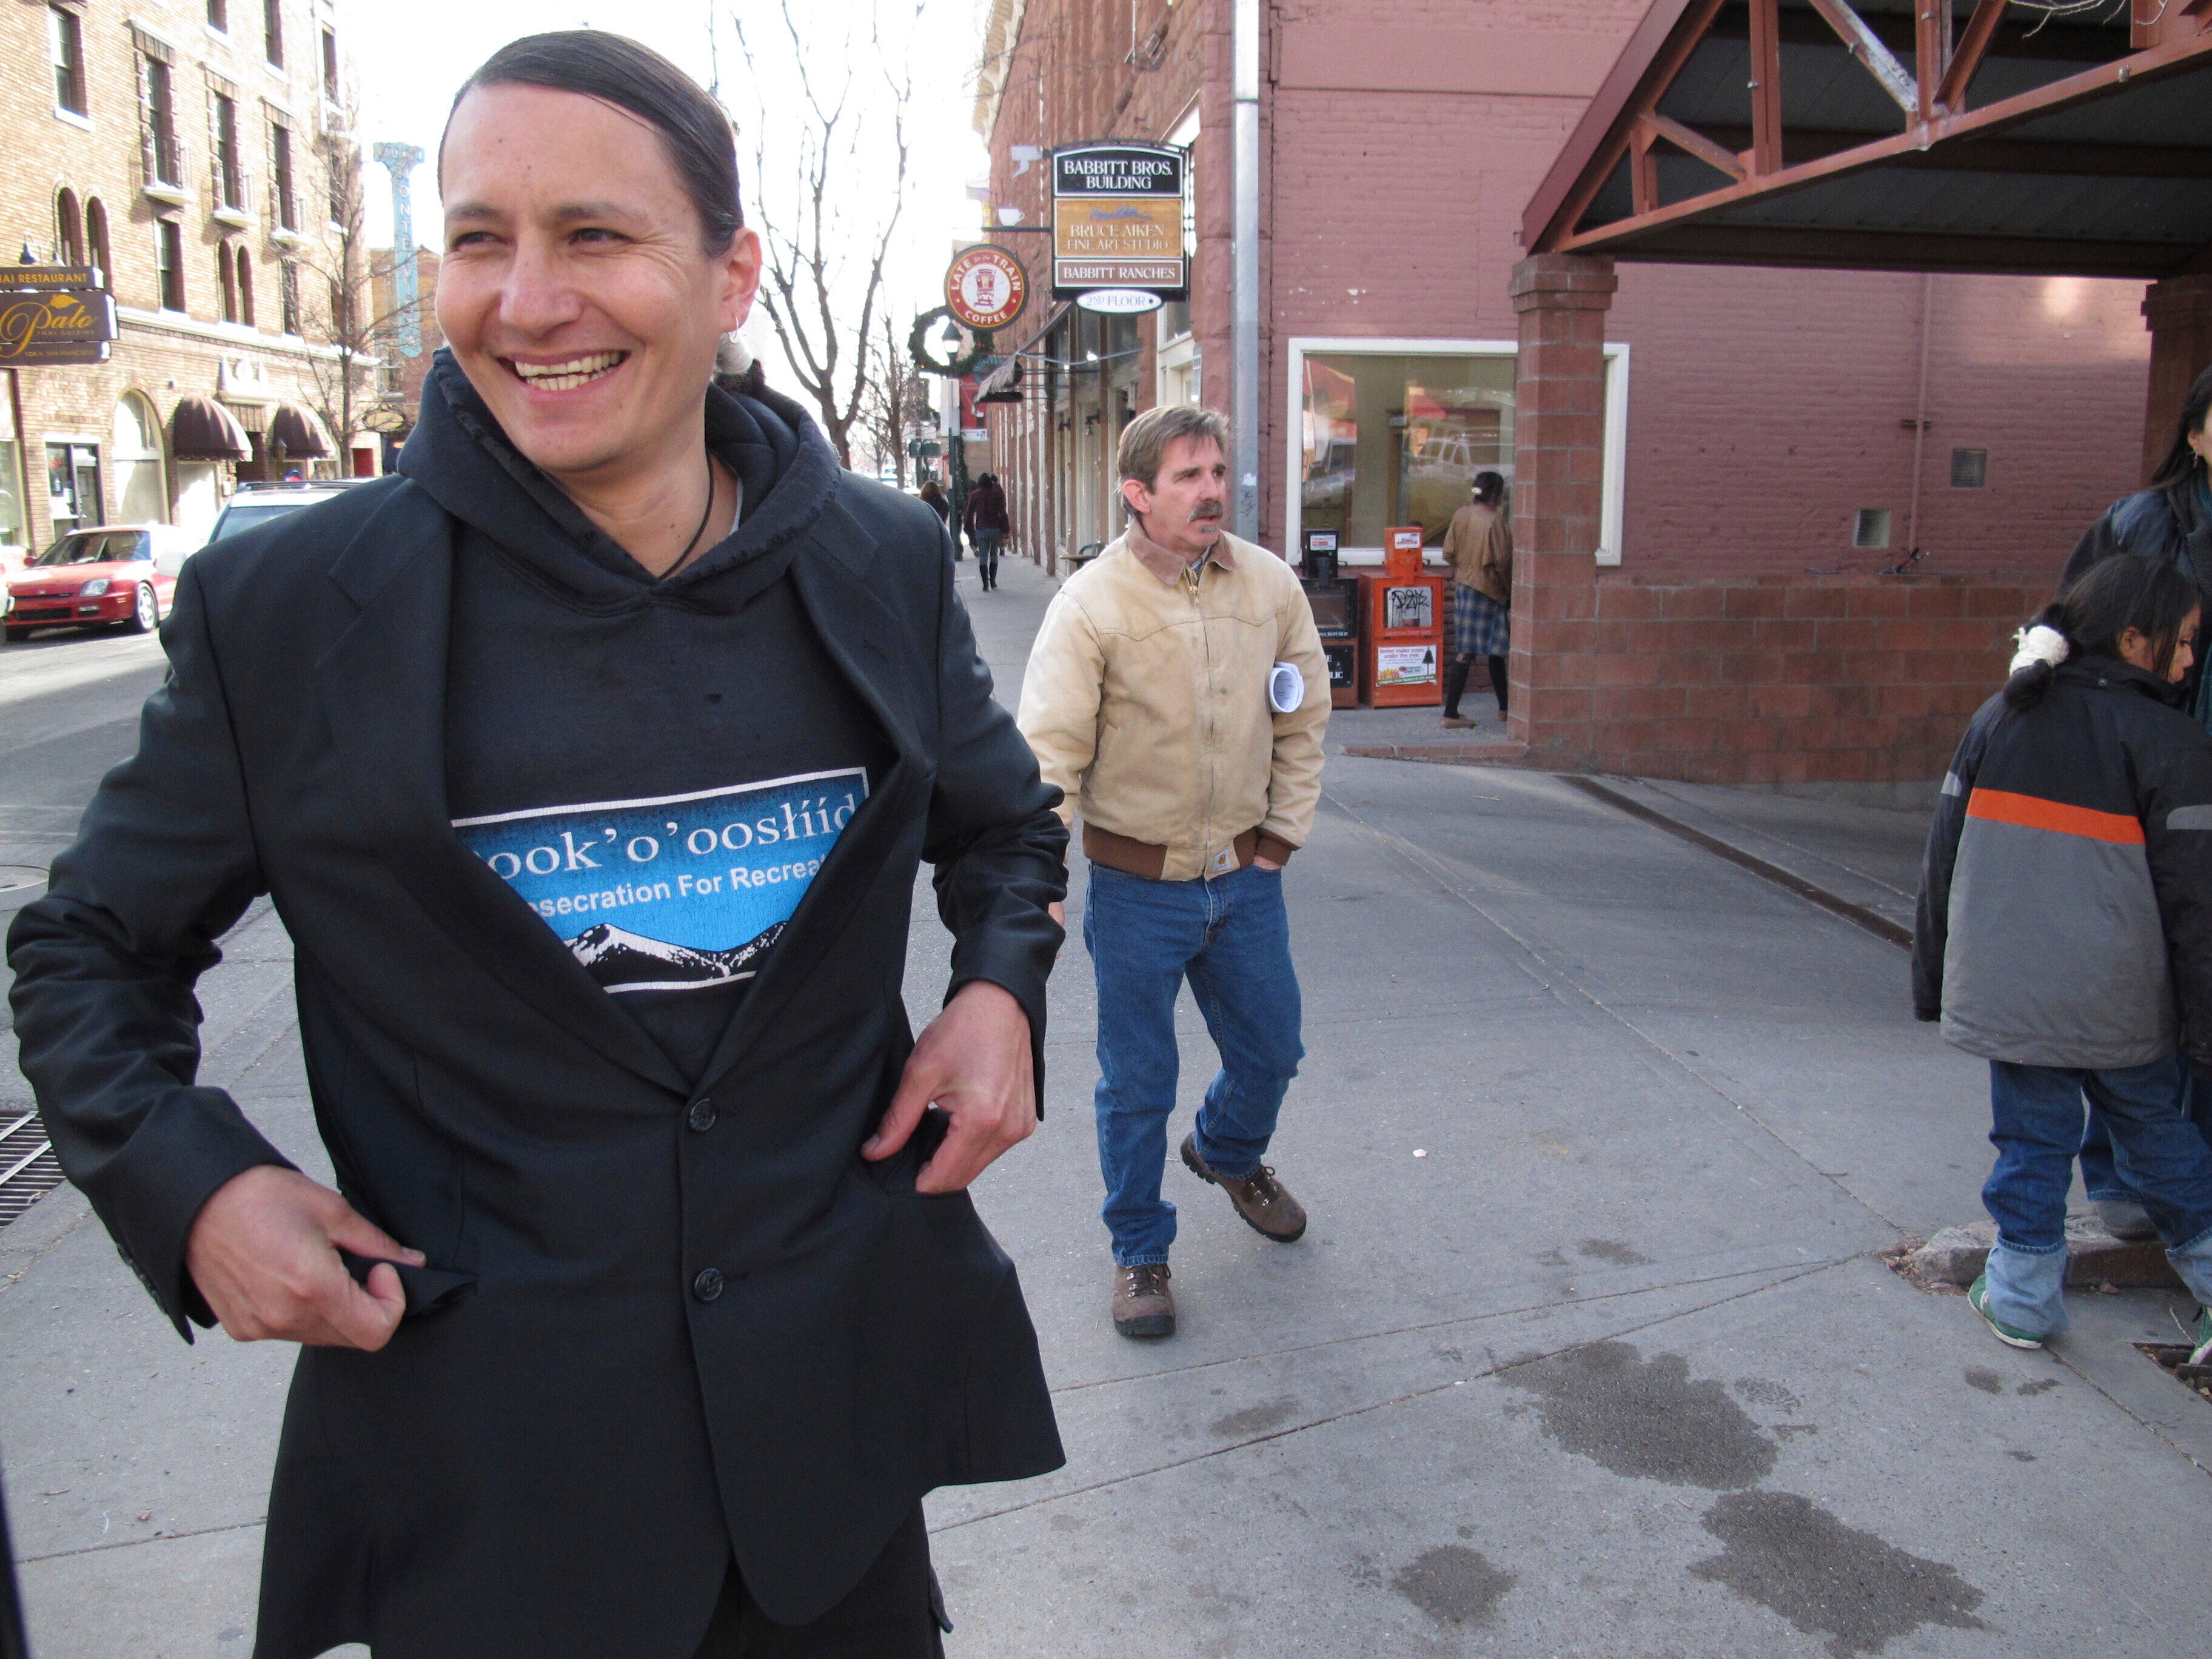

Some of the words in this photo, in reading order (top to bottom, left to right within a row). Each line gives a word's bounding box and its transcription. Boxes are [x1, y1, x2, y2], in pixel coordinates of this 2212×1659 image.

[1064, 160, 1128, 175] BABBITT
[1132, 161, 1173, 176] BROS.
[1086, 176, 1153, 190] BUILDING
[1070, 224, 1119, 238] BRUCE
[1122, 224, 1165, 238] AIKEN
[1067, 239, 1094, 250] FINE
[1096, 239, 1120, 250] ART
[1124, 240, 1168, 250] STUDIO
[0, 274, 15, 283] AI
[18, 273, 87, 283] RESTAURANT
[951, 259, 973, 290] LATE
[993, 255, 1022, 291] TRAIN
[1064, 267, 1116, 279] BABBITT
[1119, 267, 1176, 279] RANCHES
[1108, 296, 1147, 306] FLOOR
[965, 310, 1008, 324] COFFEE
[528, 882, 671, 917] secration
[677, 874, 723, 897] For
[729, 854, 826, 890] Recrea
